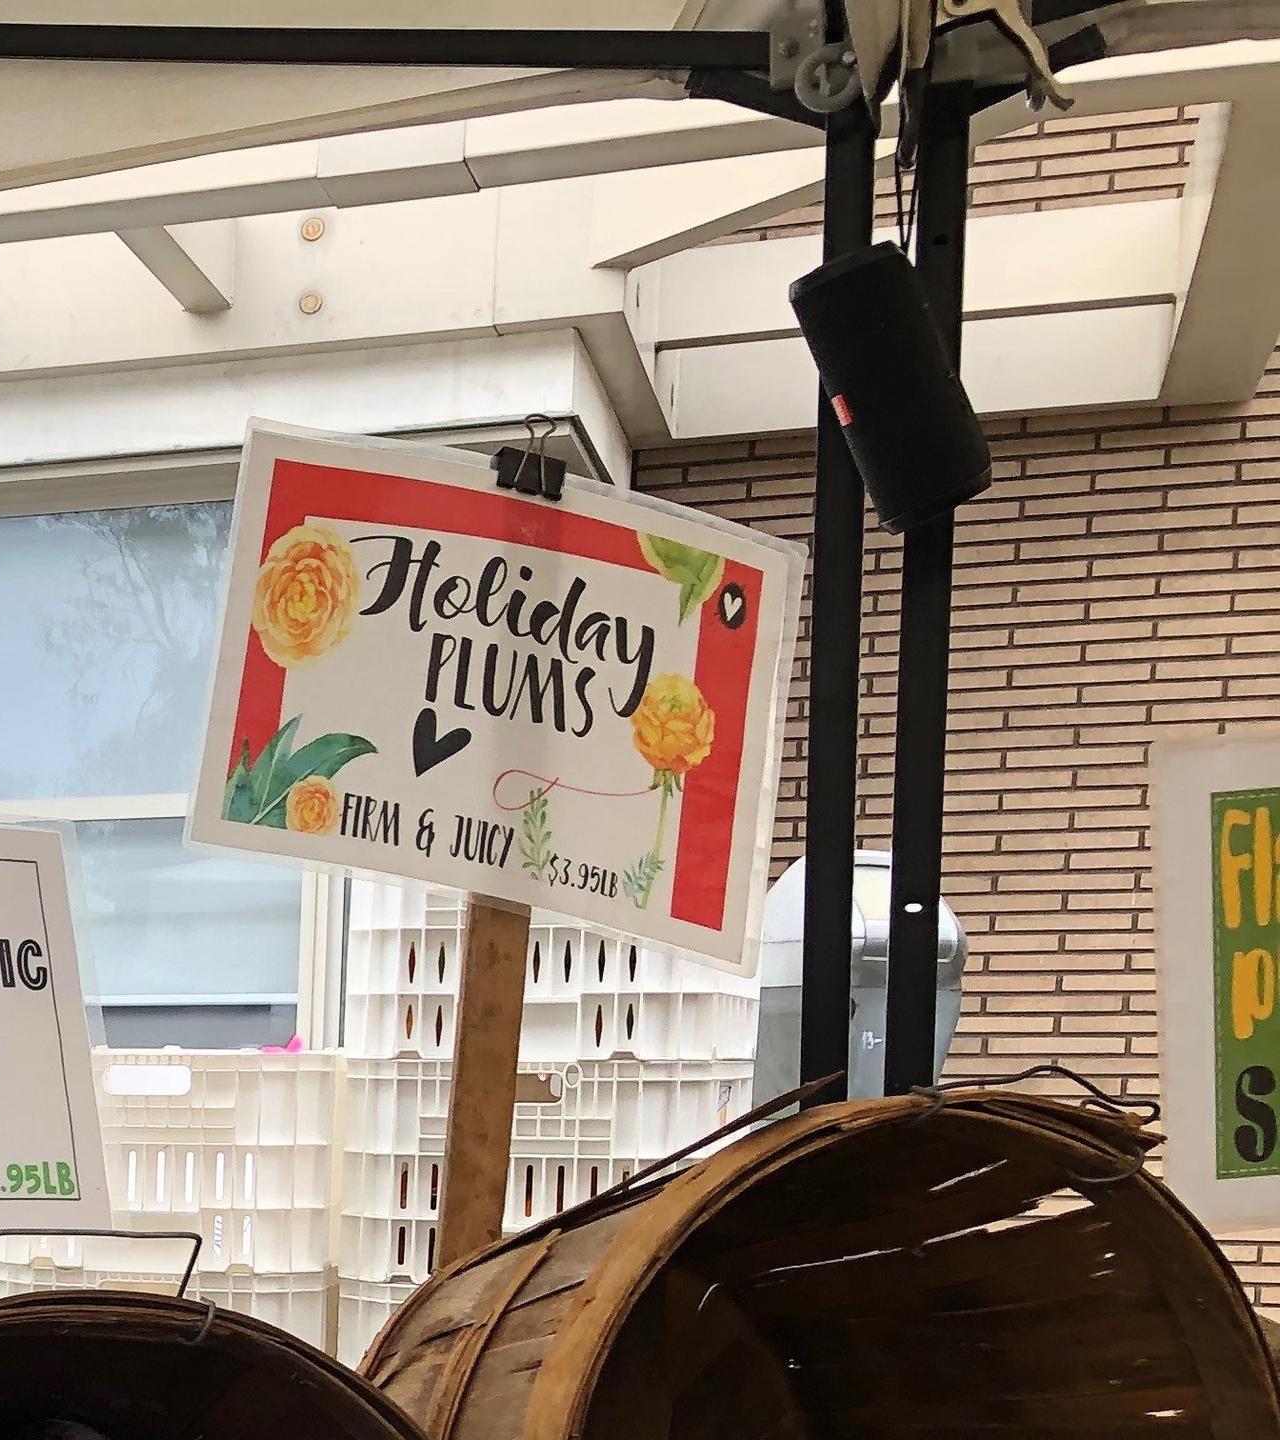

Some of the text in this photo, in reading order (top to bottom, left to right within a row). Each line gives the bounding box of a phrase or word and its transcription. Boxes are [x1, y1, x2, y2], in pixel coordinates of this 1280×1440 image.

[350, 534, 655, 717] Holiday
[424, 633, 596, 739] PLUMS
[340, 792, 515, 869] FIRM & JUICY
[548, 852, 618, 899] $3.95LB
